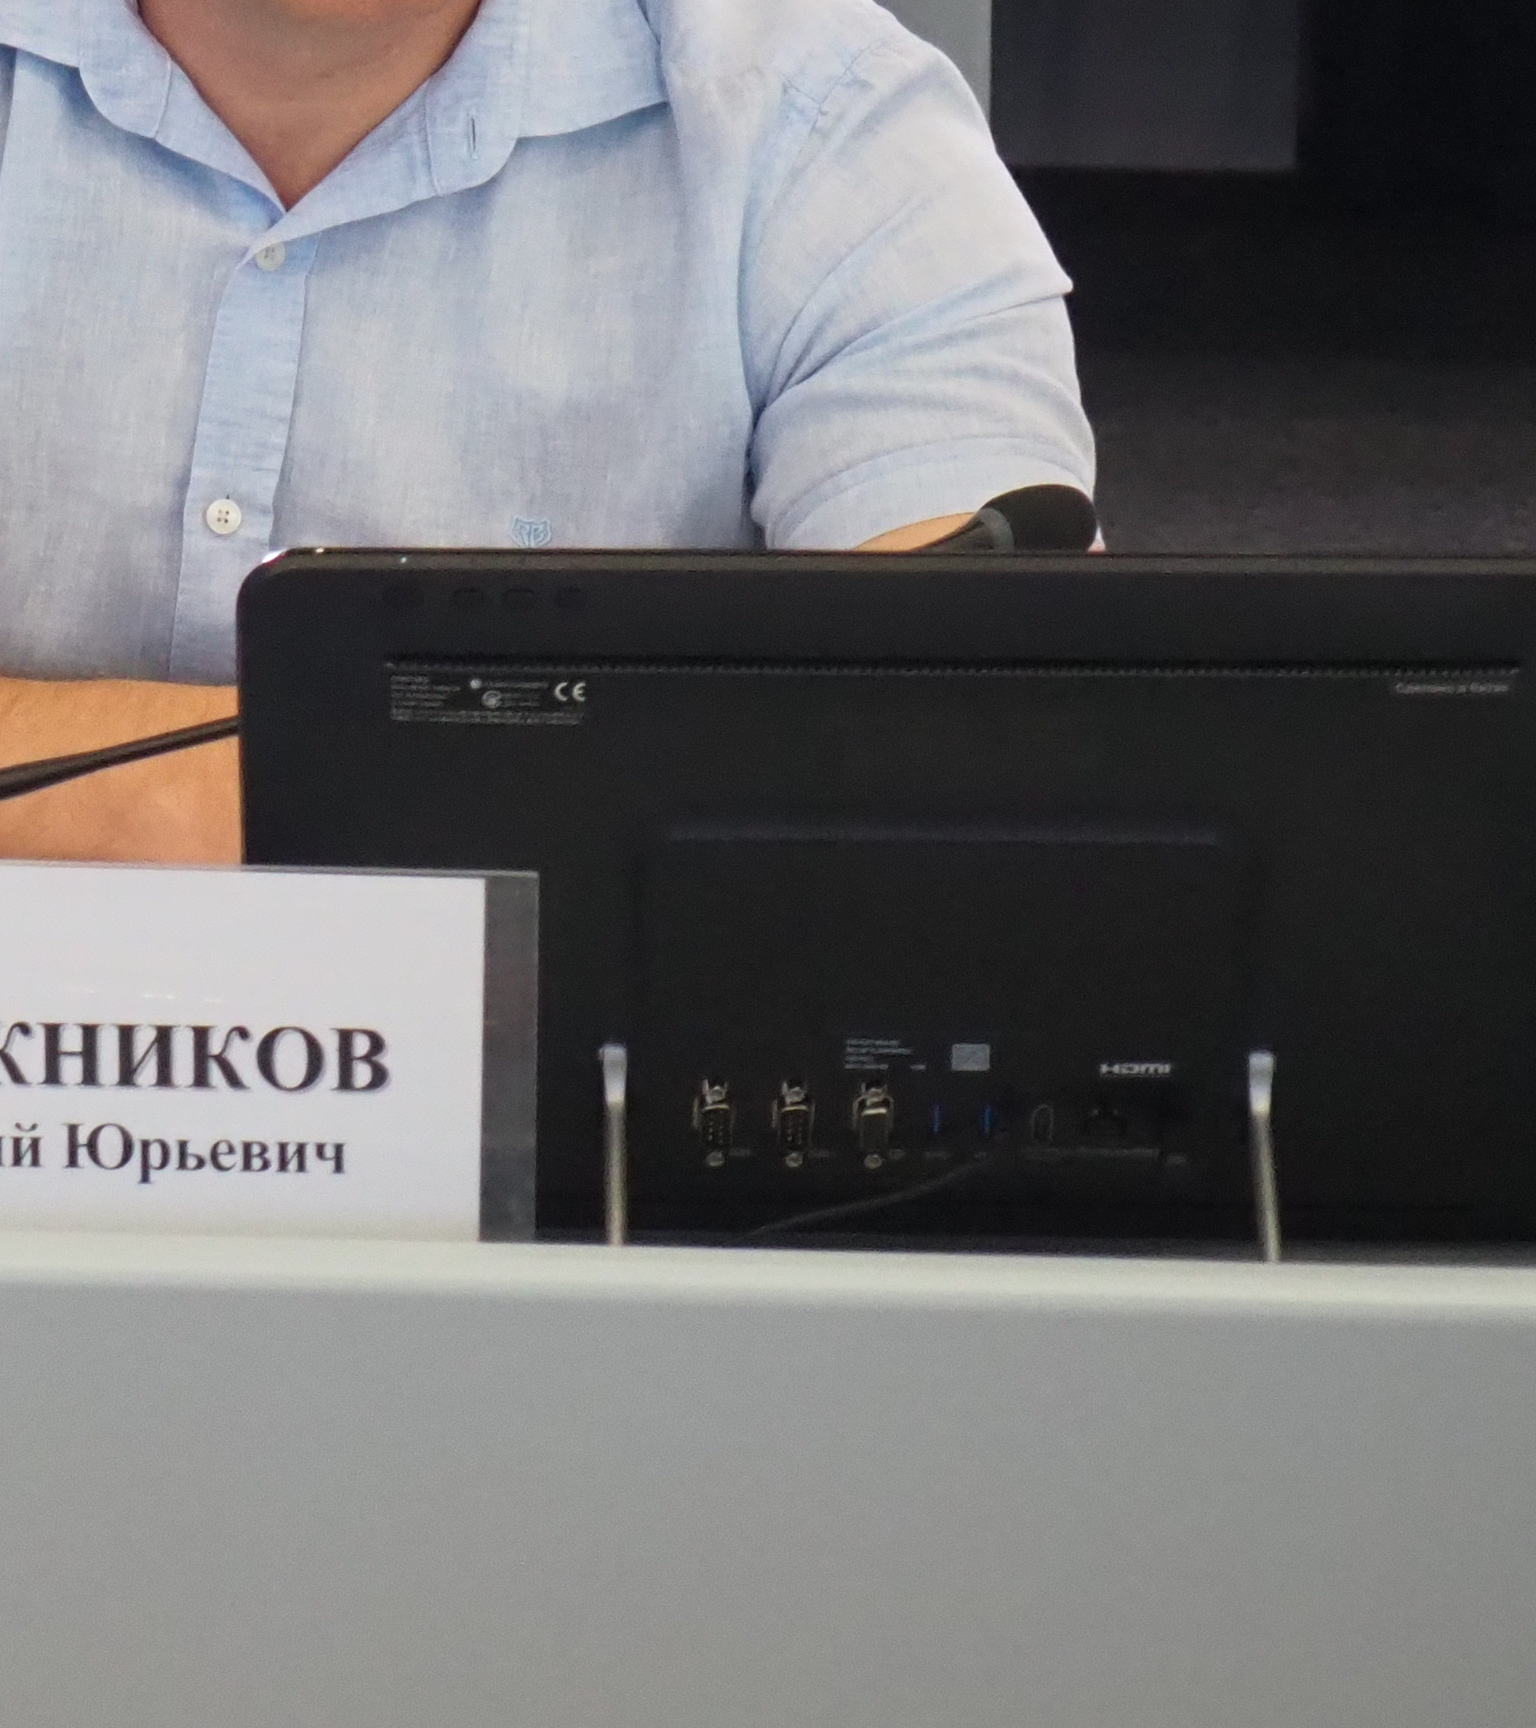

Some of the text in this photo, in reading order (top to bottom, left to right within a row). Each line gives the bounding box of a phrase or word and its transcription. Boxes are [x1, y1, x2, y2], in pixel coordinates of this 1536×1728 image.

[554, 682, 586, 702] CE
[1099, 1062, 1172, 1075] HDMI
[64, 1124, 346, 1184] Юрьевич
